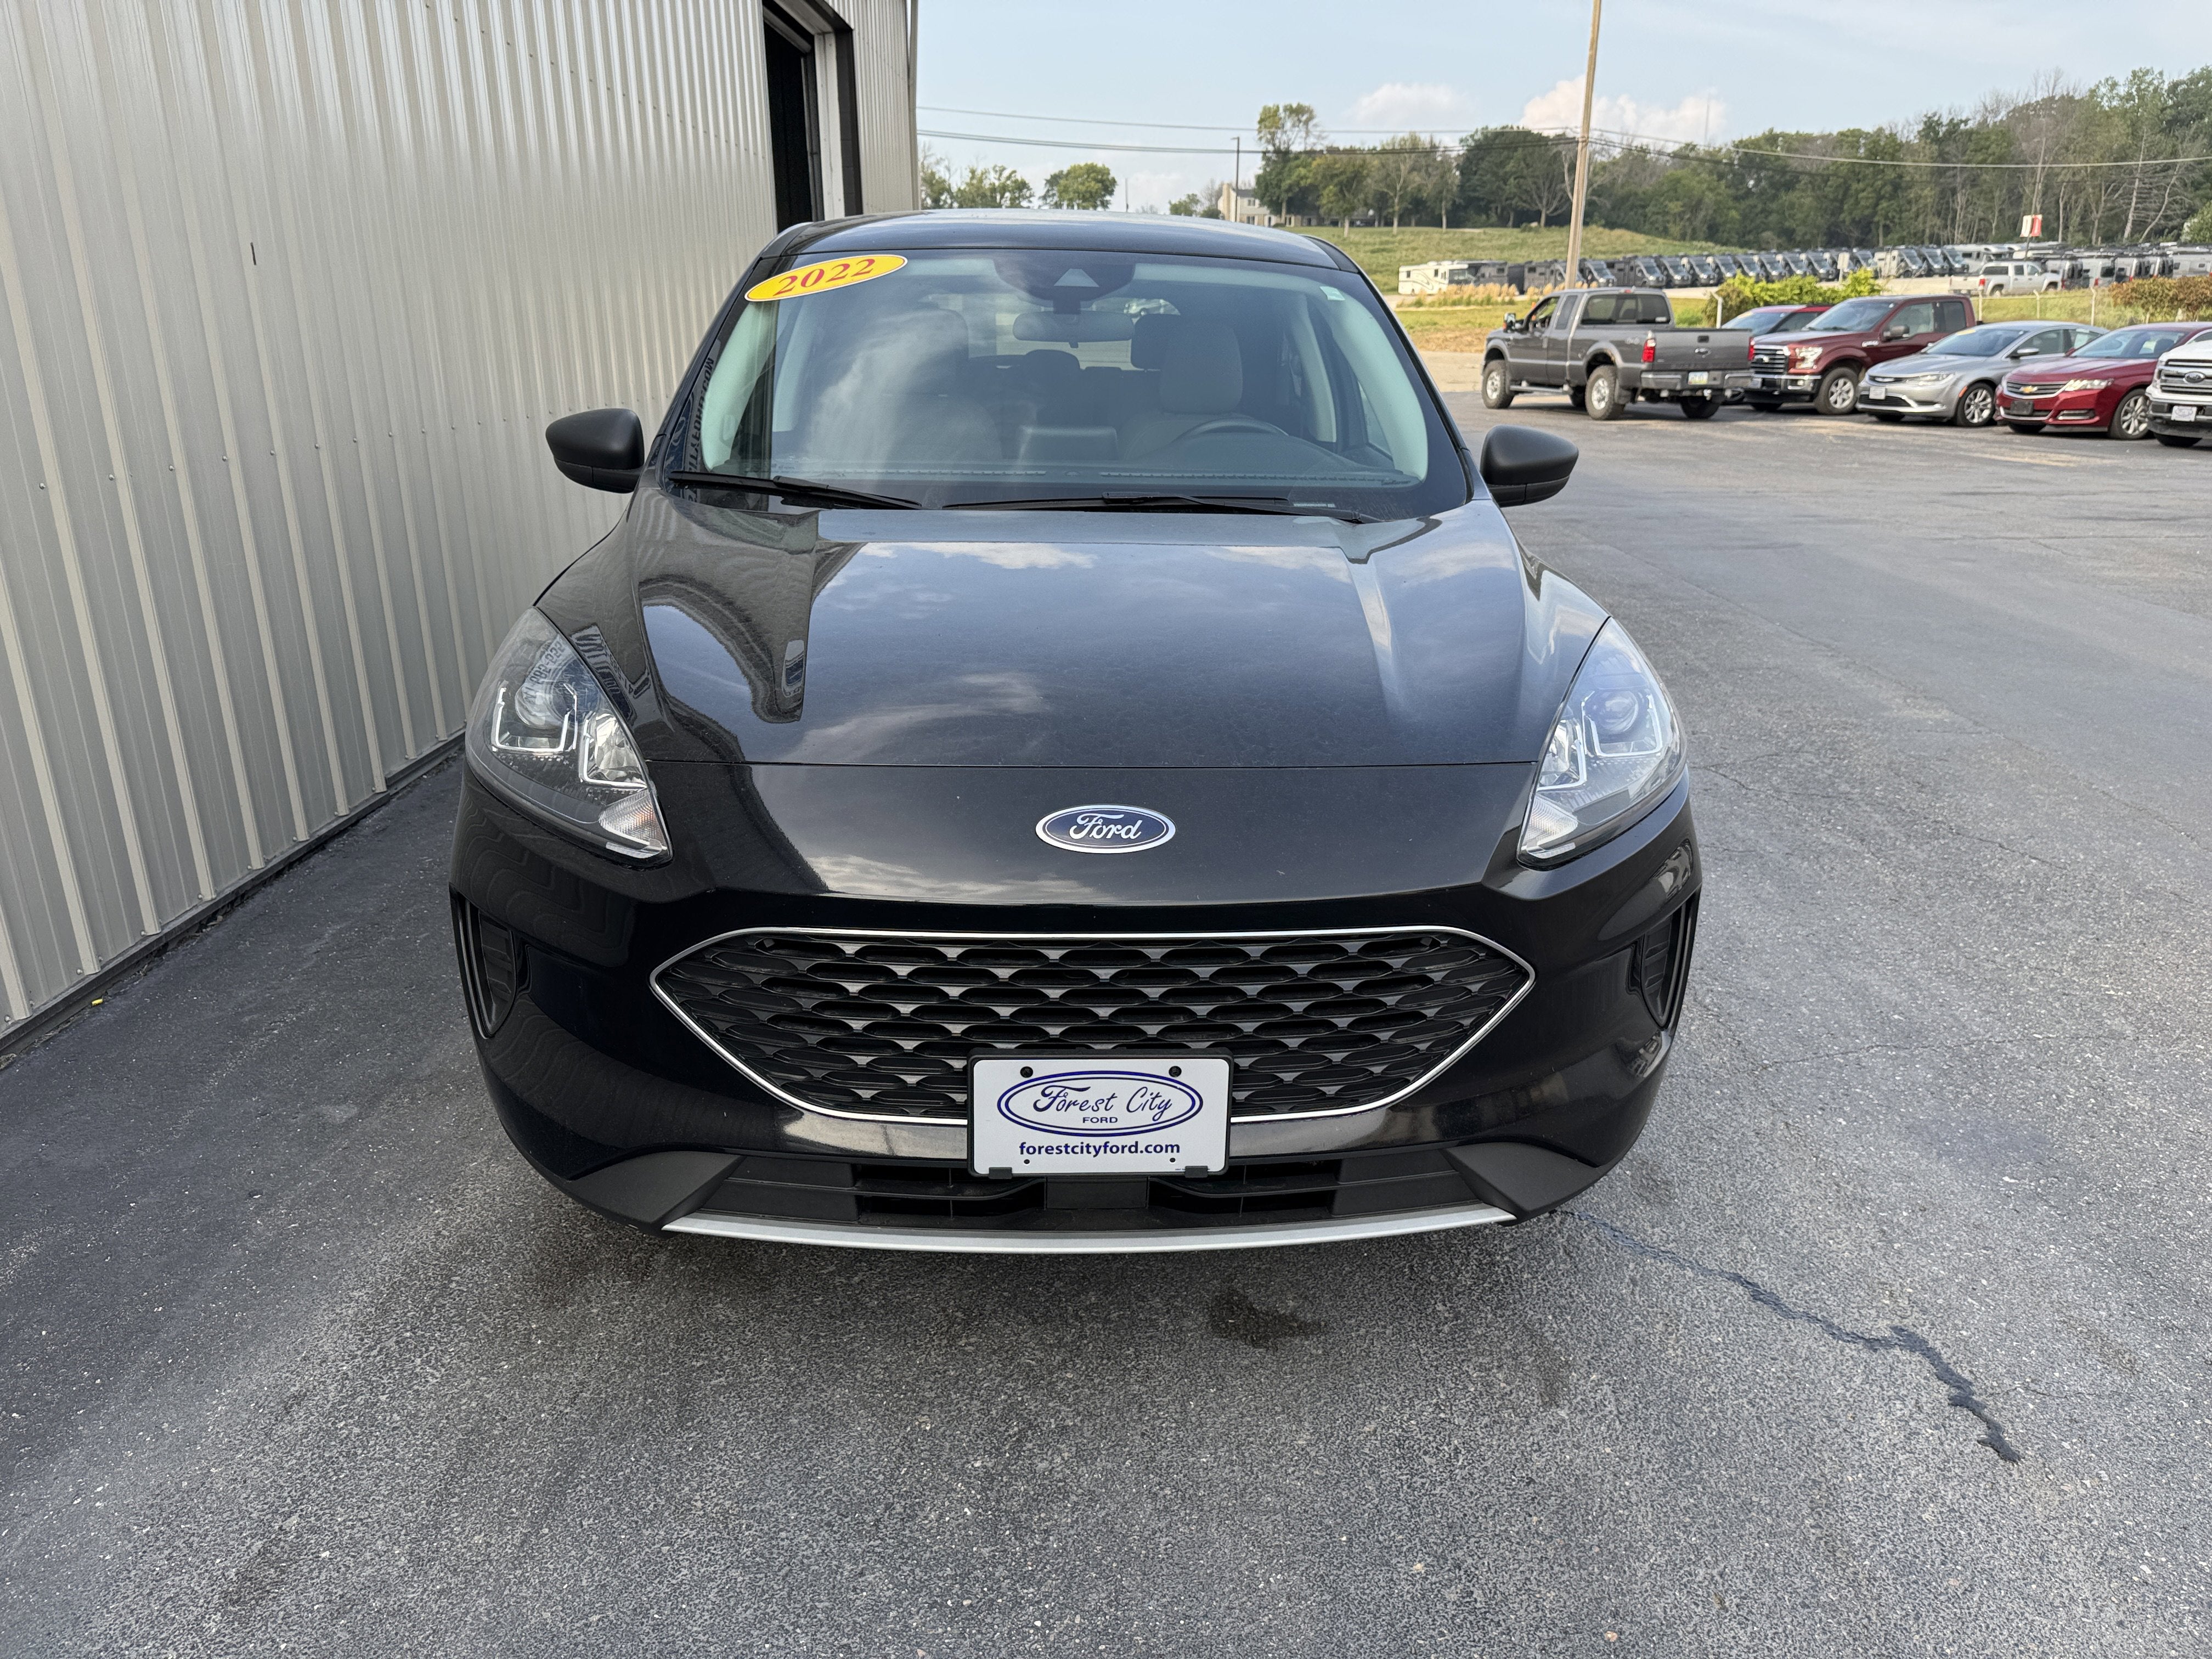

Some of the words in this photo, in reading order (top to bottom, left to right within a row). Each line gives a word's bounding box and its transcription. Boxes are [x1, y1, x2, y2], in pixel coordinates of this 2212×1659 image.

[772, 258, 875, 296] 2022
[1069, 812, 1143, 839] Ford
[1033, 1085, 1118, 1112] Forest
[1126, 1086, 1172, 1121] City
[1019, 1141, 1180, 1158] forestcityford.com
